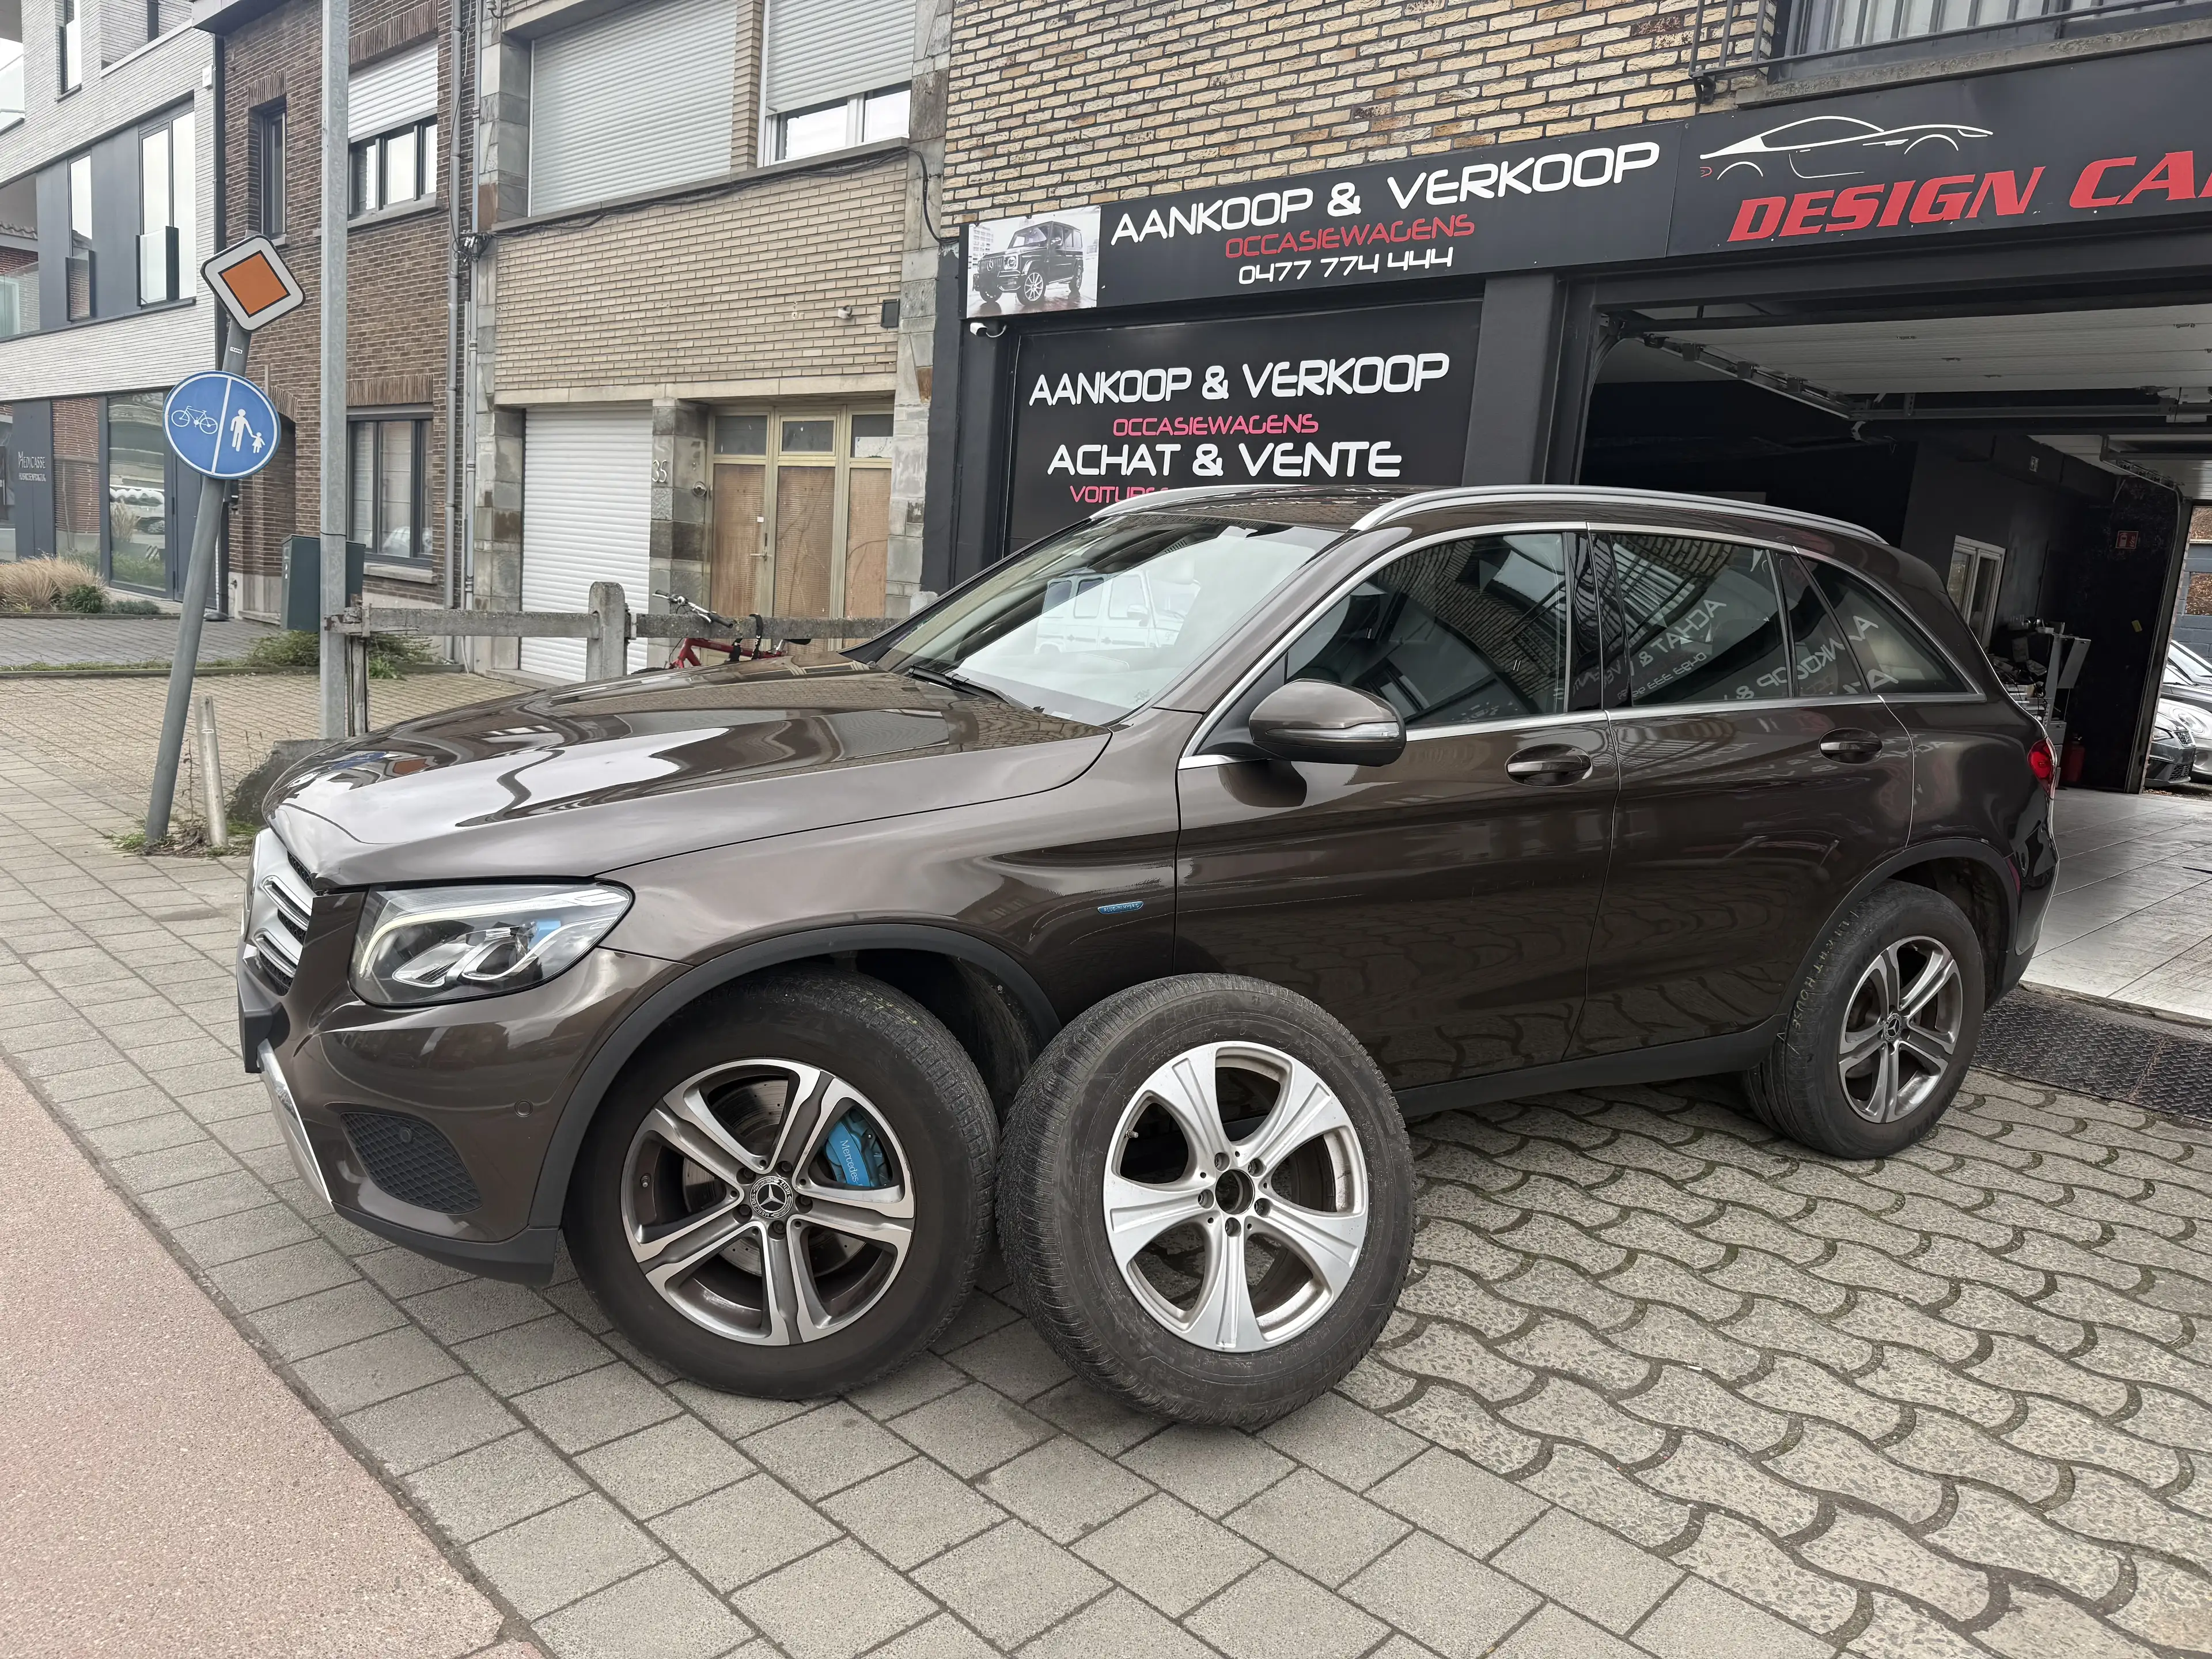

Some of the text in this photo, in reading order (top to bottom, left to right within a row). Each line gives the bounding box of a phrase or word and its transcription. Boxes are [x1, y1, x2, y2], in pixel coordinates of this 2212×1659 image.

[1111, 142, 1660, 246] AANKOOP & VERKOOP
[1728, 151, 2212, 242] DESIGN CA
[1225, 214, 1475, 259] OCCASIEWAGENS
[1238, 247, 1453, 285] 0477 774 444
[1029, 353, 1450, 406] AANKOOP & VERKOOP
[1113, 414, 1319, 437] OCCASIEWAGENS
[652, 459, 667, 483] 35
[1047, 441, 1402, 478] ACHAT & VENTE
[839, 1139, 863, 1186] Mercedes-
[751, 1193, 770, 1218] MERCEDES
